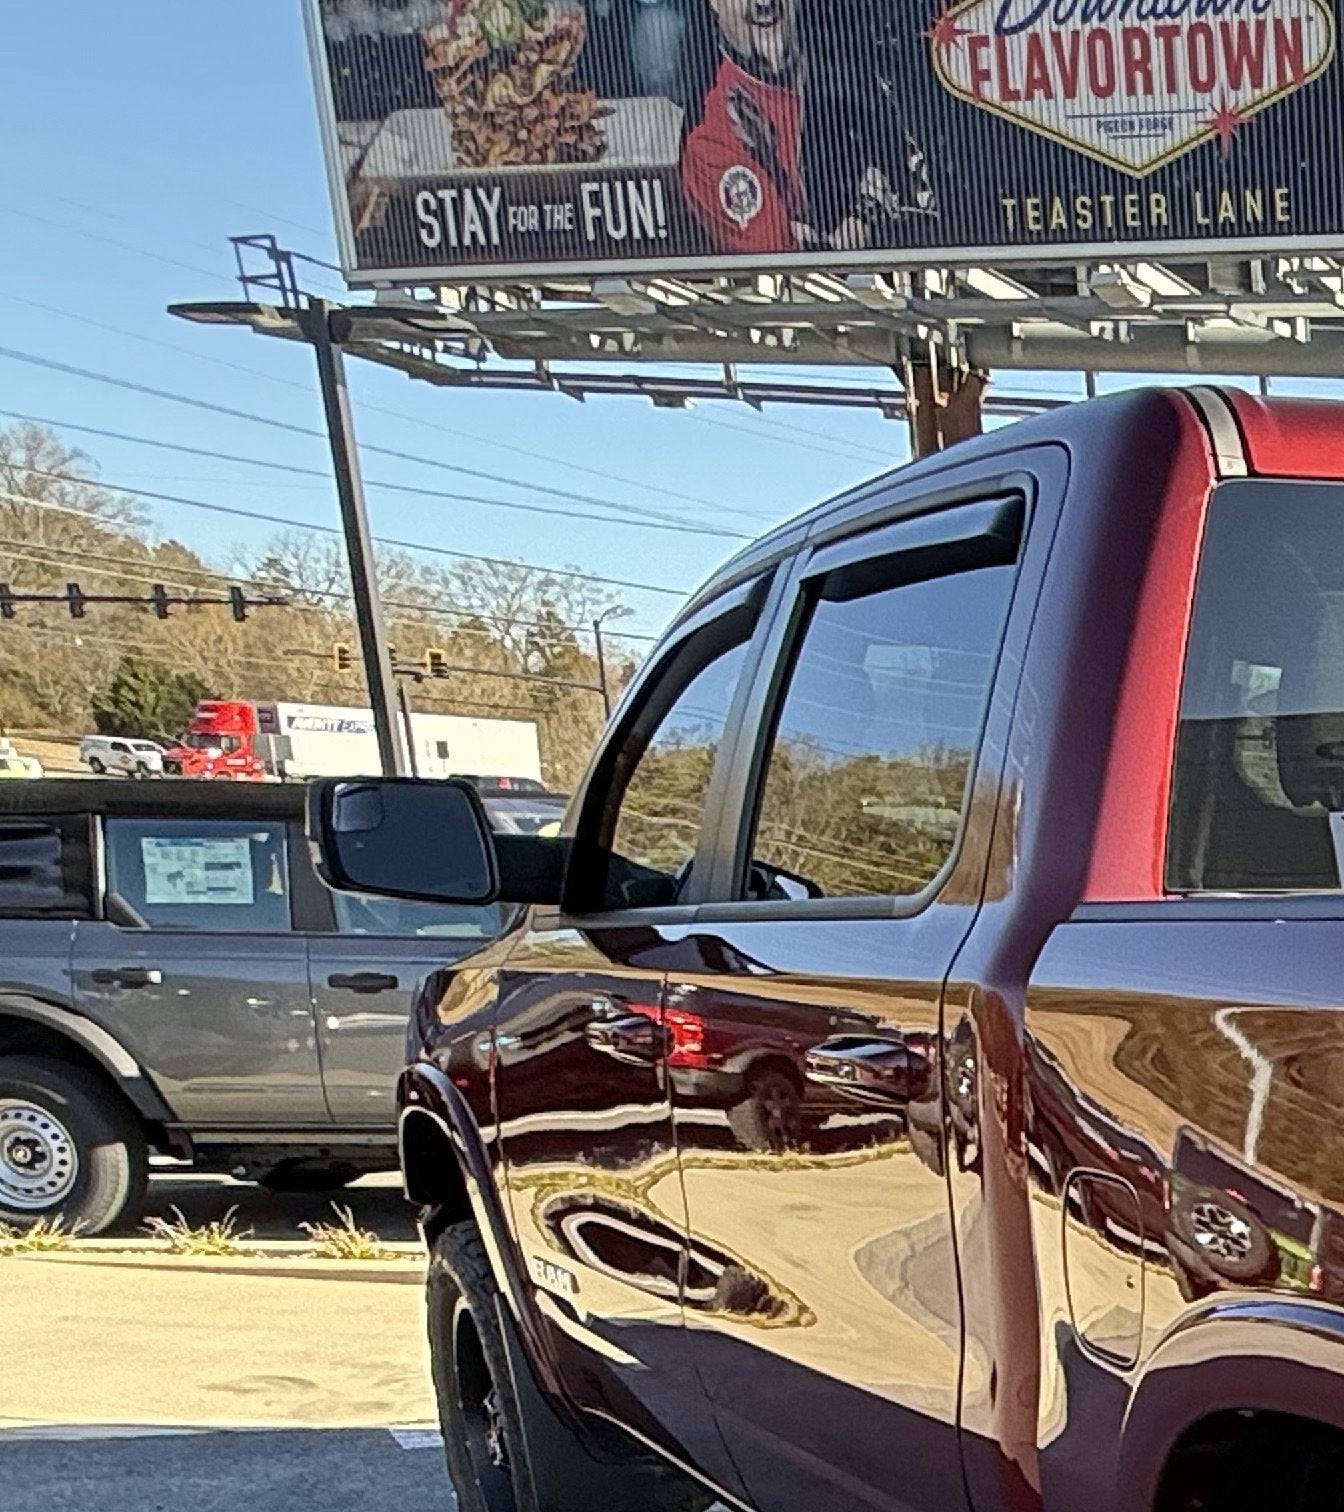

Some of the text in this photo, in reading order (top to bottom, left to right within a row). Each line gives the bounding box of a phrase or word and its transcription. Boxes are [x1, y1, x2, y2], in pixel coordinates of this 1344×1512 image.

[968, 17, 1305, 101] FLAVORTOWN
[416, 179, 668, 248] STAY FOR THE FUN!
[1001, 188, 1291, 231] TEASTER LANE
